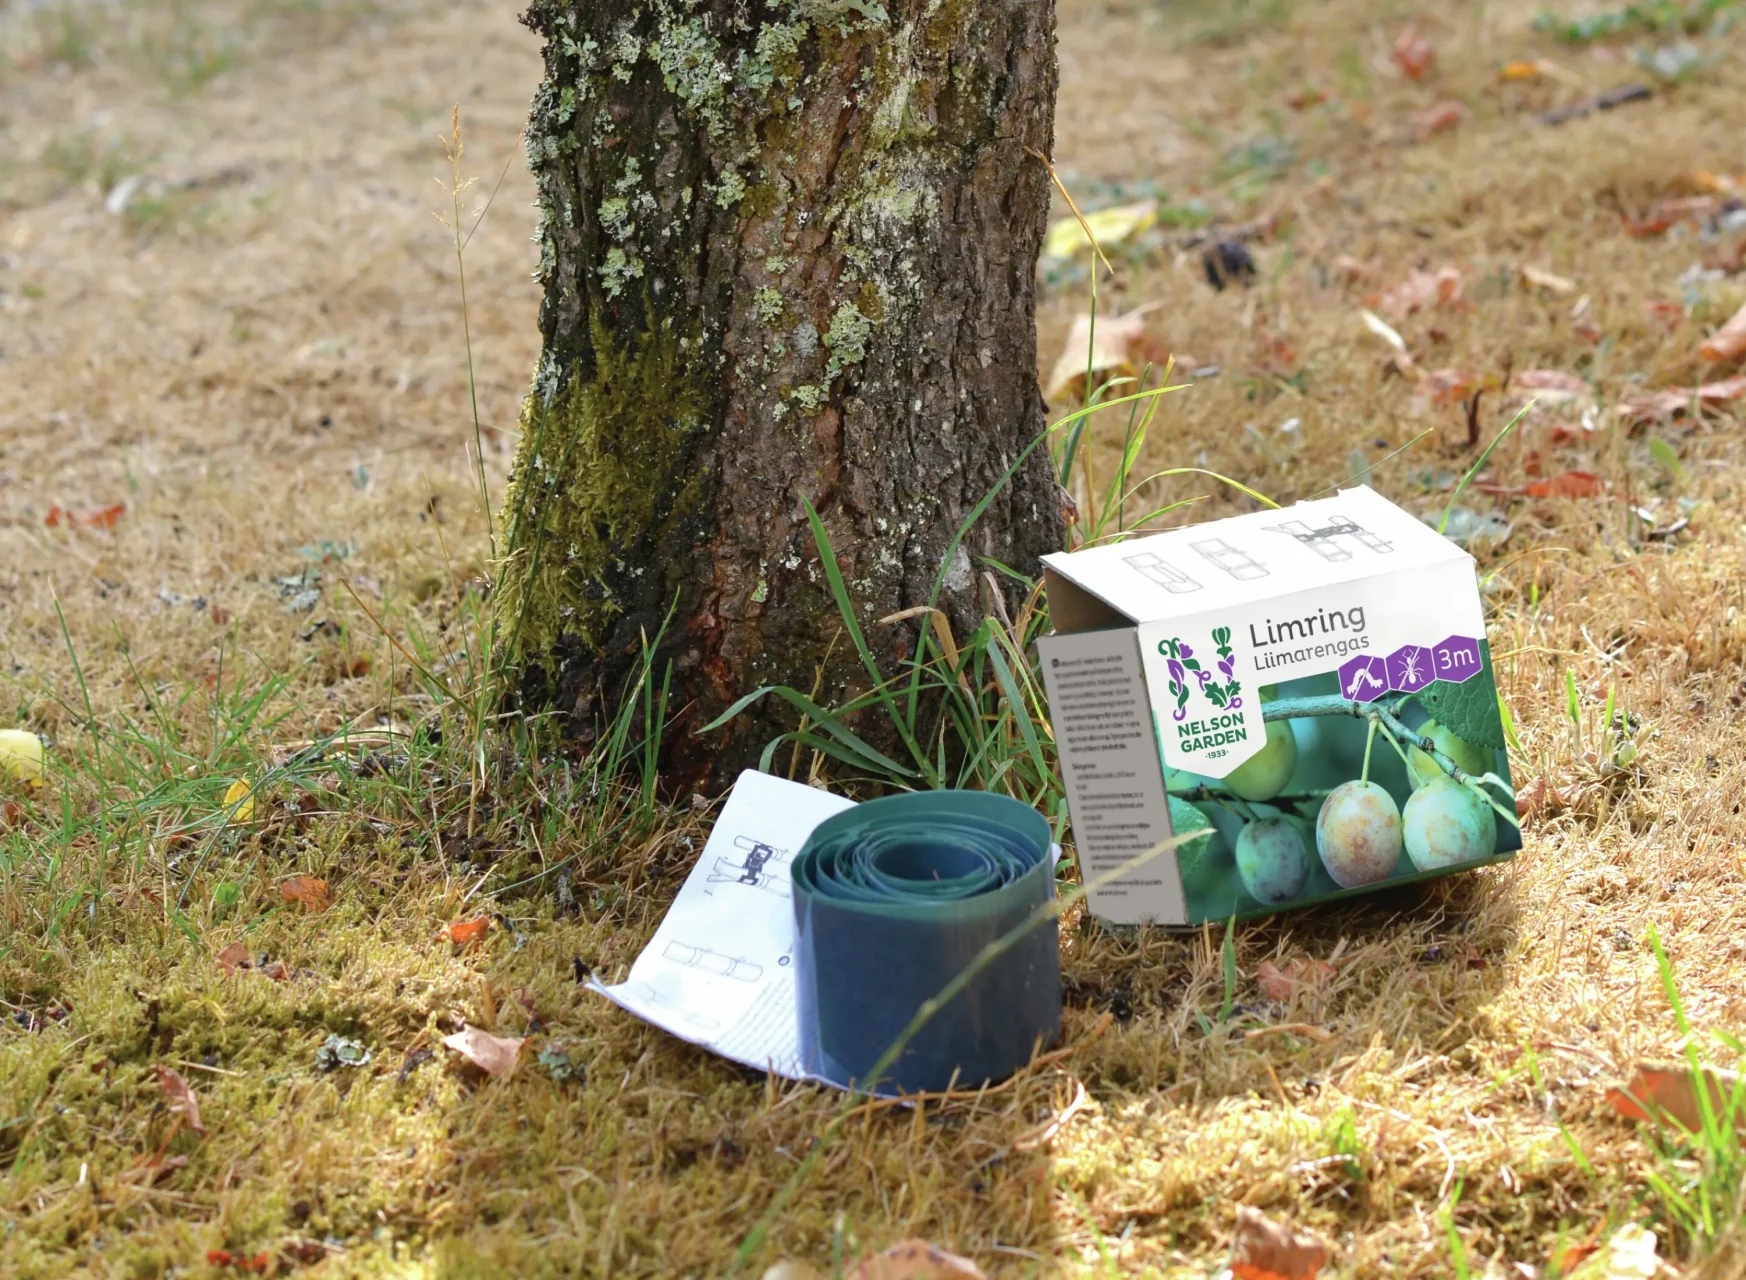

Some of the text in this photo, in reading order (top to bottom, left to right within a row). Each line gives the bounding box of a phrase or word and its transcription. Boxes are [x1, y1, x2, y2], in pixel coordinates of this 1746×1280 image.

[1249, 605, 1367, 648] Limring
[1253, 635, 1370, 671] Liimarengas
[1437, 647, 1475, 670] 3m
[1177, 711, 1245, 738] NELSON
[1180, 727, 1248, 753] GARDEN
